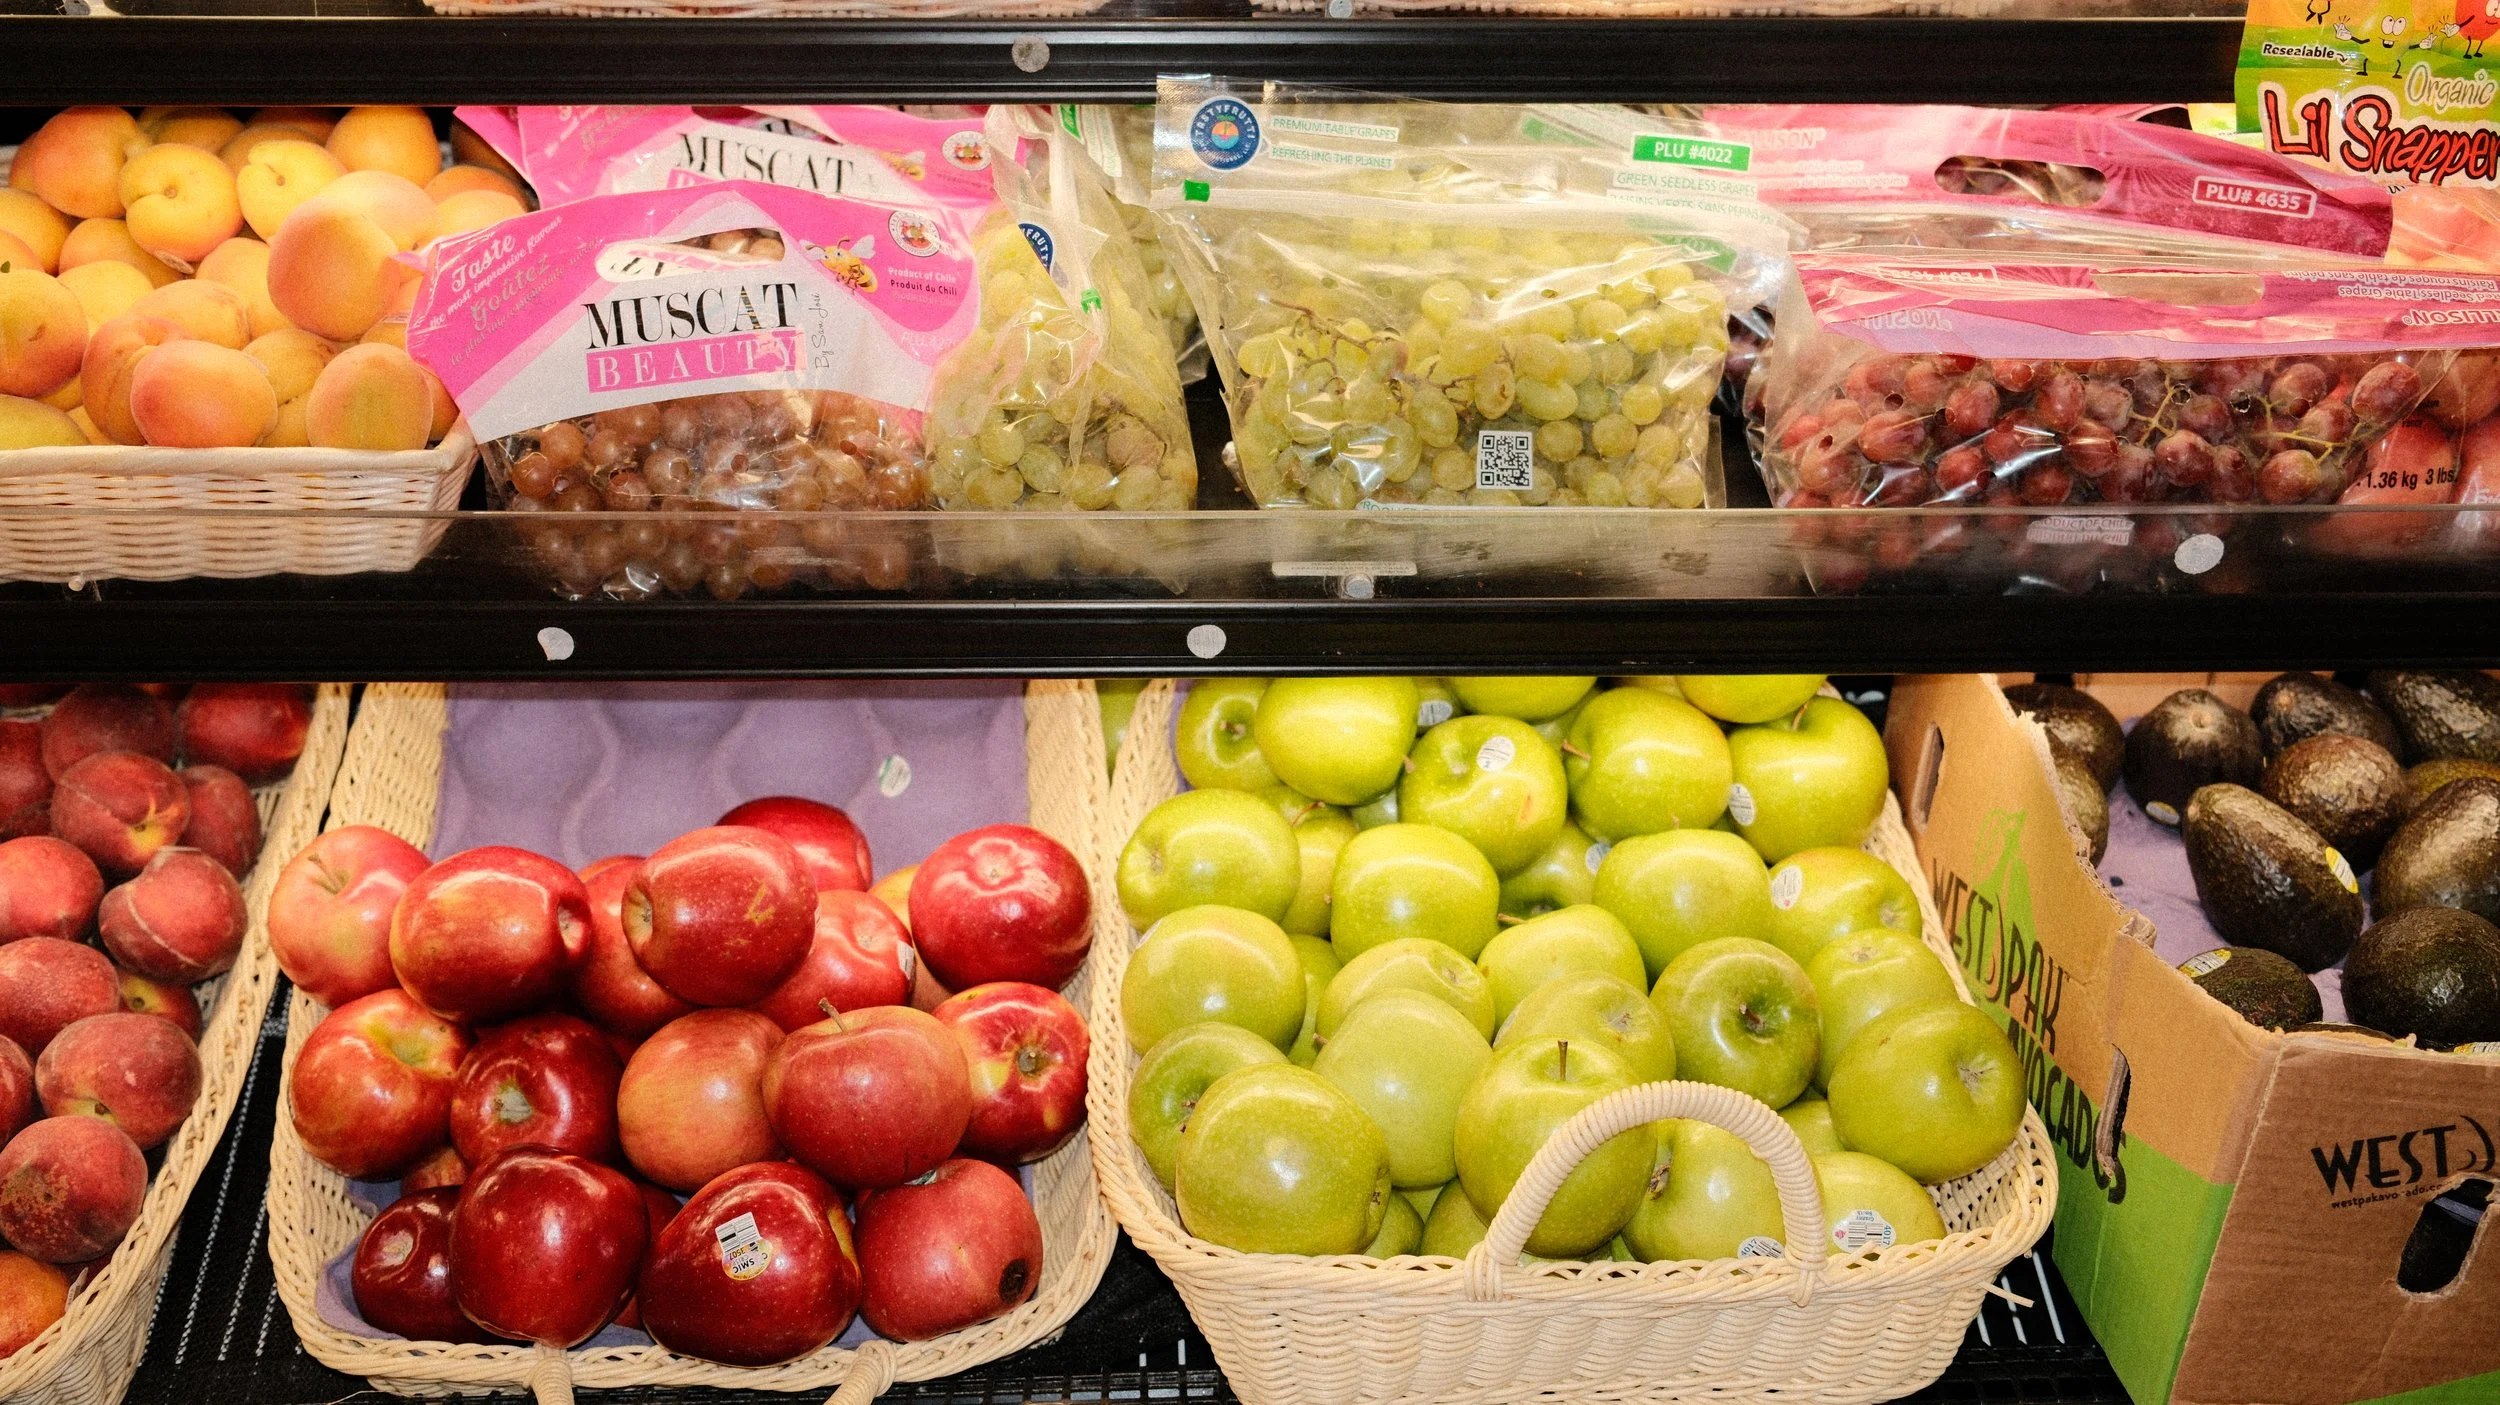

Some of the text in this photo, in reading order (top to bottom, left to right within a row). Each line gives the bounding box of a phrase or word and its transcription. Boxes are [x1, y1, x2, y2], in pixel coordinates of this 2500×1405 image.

[2263, 44, 2335, 60] Resealable
[2407, 64, 2496, 111] Organic
[1272, 118, 1325, 133] PREMIUM
[1325, 123, 1355, 136] TABLE
[2264, 90, 2331, 162] Lil
[676, 132, 855, 194] MUSCAT
[1272, 147, 1392, 168] REFRESHING THE PLANET
[1654, 140, 1733, 165] PLU #4022
[1616, 171, 1756, 196] GREEN SEEDLESS GRAPES
[2255, 188, 2301, 210] 4635
[447, 289, 472, 316] most
[474, 250, 526, 293] impressive
[527, 215, 563, 254] flavour
[452, 235, 516, 293] Taste
[888, 266, 958, 285] Product of Chile
[2391, 274, 2406, 285] de
[2452, 278, 2495, 291] Raisins
[890, 279, 923, 292] Produit
[925, 284, 936, 294] du
[937, 284, 958, 297] Chili
[2338, 285, 2382, 298] Grapes
[2385, 288, 2418, 300] Table
[2420, 289, 2475, 303] Seedless
[581, 282, 799, 350] MUSCAT
[596, 336, 797, 389] BEAUTY
[814, 349, 835, 369] By
[2366, 467, 2458, 491] 1.36 kg 3 lbs.
[1932, 856, 2063, 1056] WEST PAK
[2310, 1124, 2457, 1196] WEST
[2331, 1183, 2444, 1209] westpakavoado.co
[1883, 1224, 1892, 1245] 4017
[729, 1248, 746, 1261] 3507
[1741, 1238, 1758, 1257] 4017
